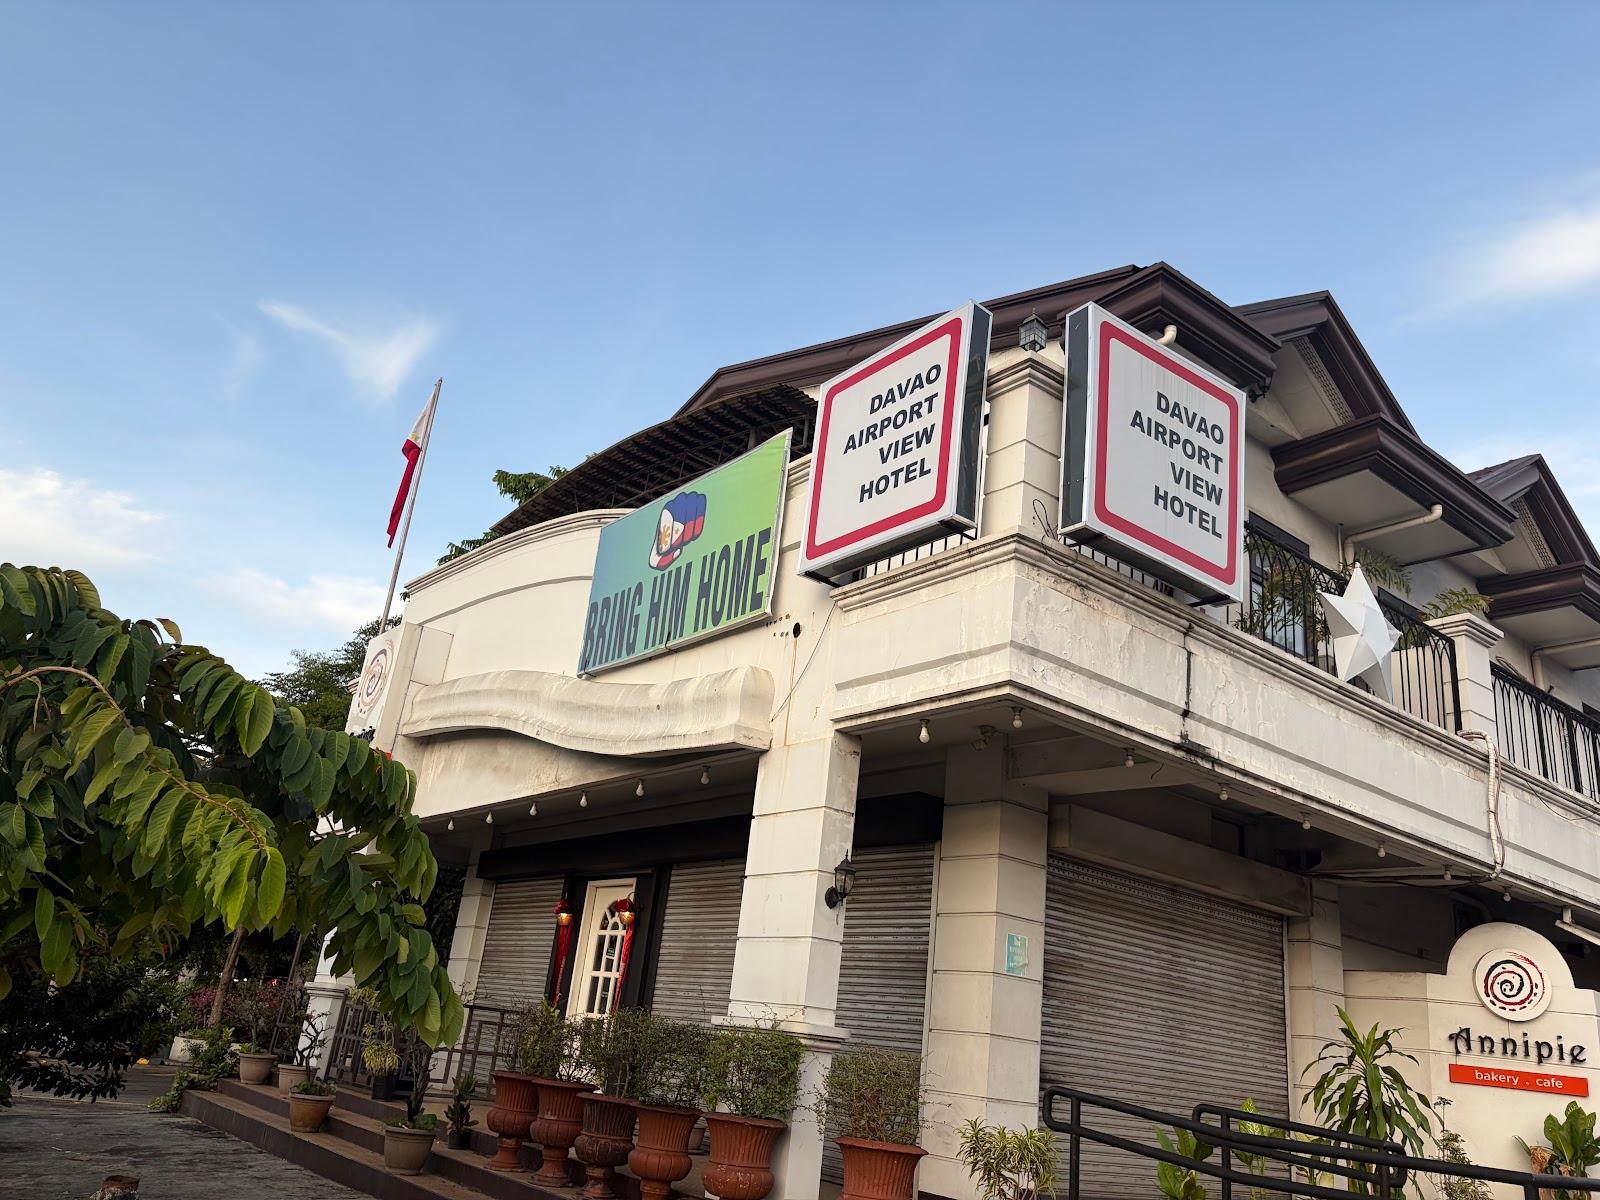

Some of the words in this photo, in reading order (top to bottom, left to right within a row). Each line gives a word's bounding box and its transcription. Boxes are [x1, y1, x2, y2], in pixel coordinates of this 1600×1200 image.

[869, 363, 942, 415] DAVAO
[843, 392, 938, 455] AIRPORT
[878, 423, 936, 465] VIEW
[1130, 410, 1223, 475] AIRPORT
[1156, 391, 1224, 445] DAVAO
[859, 457, 931, 503] HOTEL
[1170, 462, 1223, 507] VIEW
[1154, 485, 1222, 539] HOTEL
[580, 582, 644, 668] BRING
[644, 562, 693, 650] HIM
[693, 526, 772, 633] HOME
[1449, 1027, 1587, 1065] Annipie
[1475, 1070, 1519, 1086] bakery
[1535, 1077, 1563, 1089] cafe
